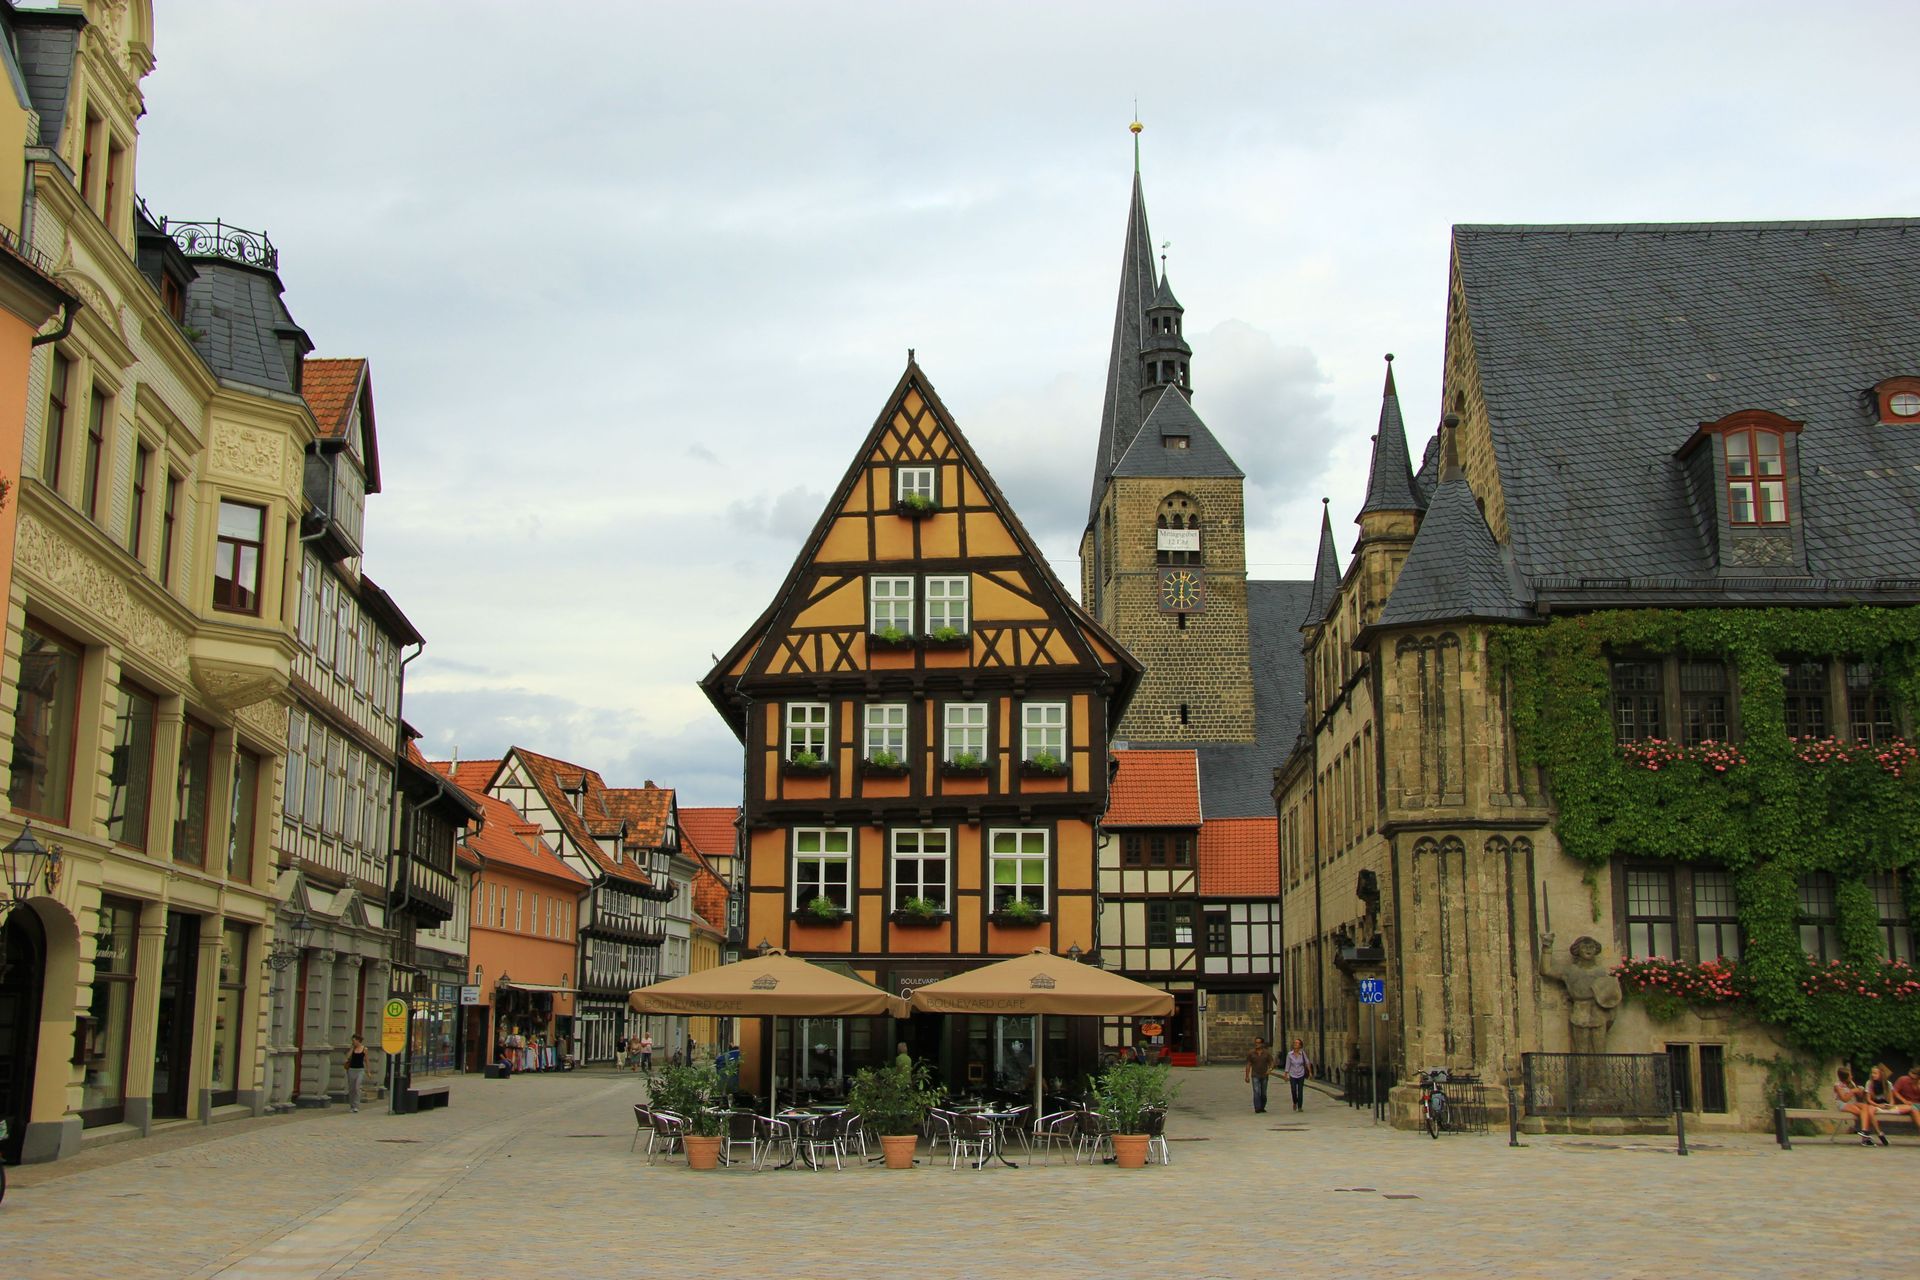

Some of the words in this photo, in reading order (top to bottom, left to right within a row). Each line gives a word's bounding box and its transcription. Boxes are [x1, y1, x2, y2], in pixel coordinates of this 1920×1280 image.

[1361, 992, 1383, 1003] WC
[644, 999, 712, 1010] BOULEVARD
[927, 998, 995, 1009] BOULEVARD
